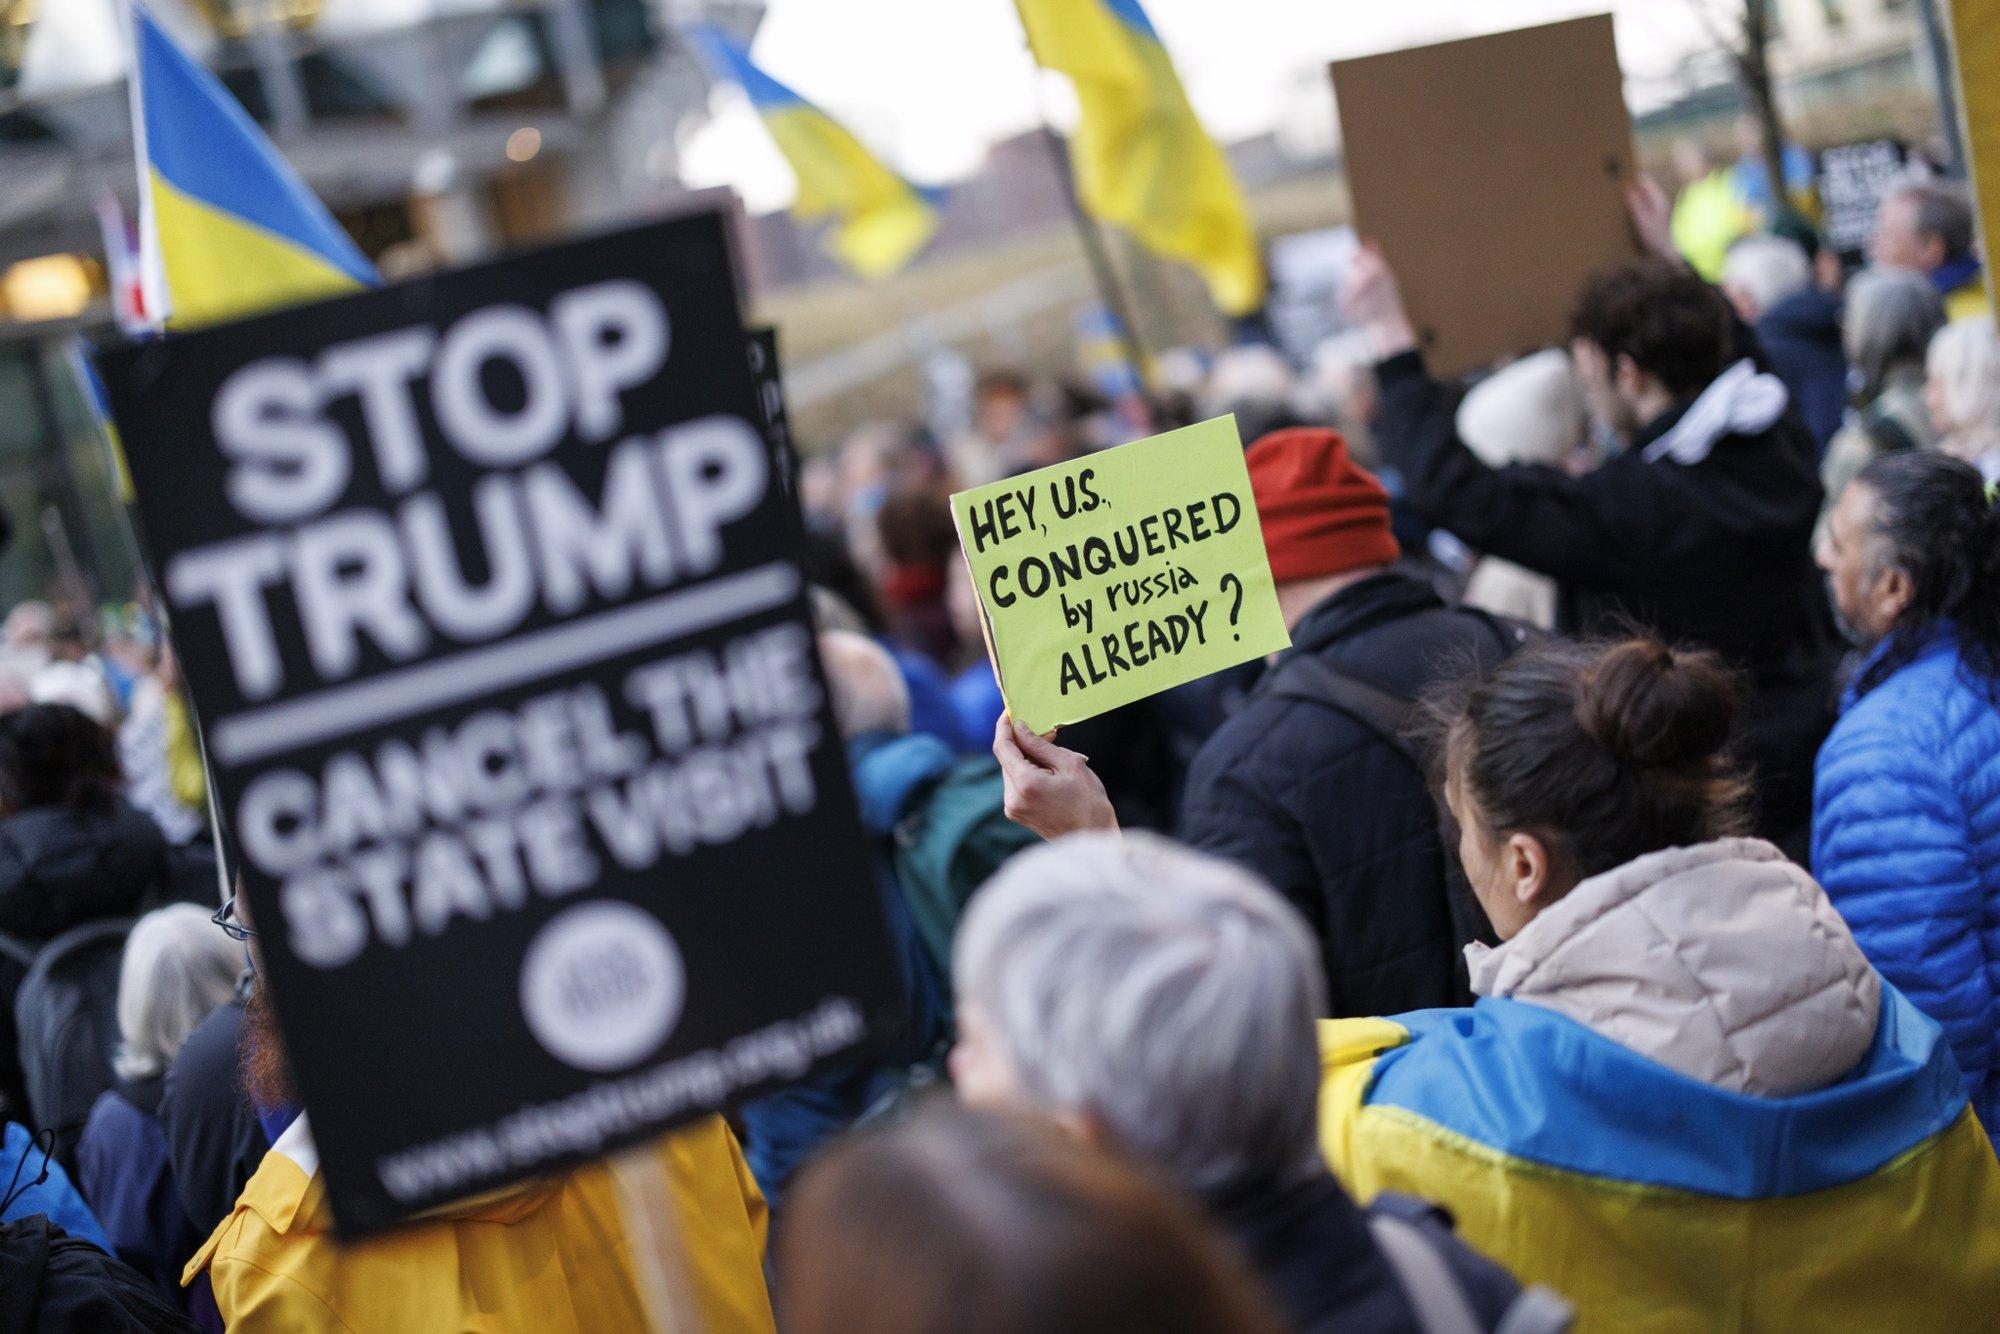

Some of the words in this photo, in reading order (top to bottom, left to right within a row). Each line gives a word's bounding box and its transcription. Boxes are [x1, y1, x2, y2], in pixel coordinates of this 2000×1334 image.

[213, 281, 668, 522] STOP
[167, 417, 767, 696] TRUMP
[969, 485, 1048, 553] HEY,
[989, 491, 1242, 608] CONQUERED
[1060, 593, 1094, 633] by
[1105, 560, 1199, 613] russia
[1059, 600, 1209, 696] ALREADY
[237, 681, 650, 877] CANCEL
[623, 622, 821, 758] THE
[281, 798, 600, 968] STATE
[587, 720, 822, 870] VISIT
